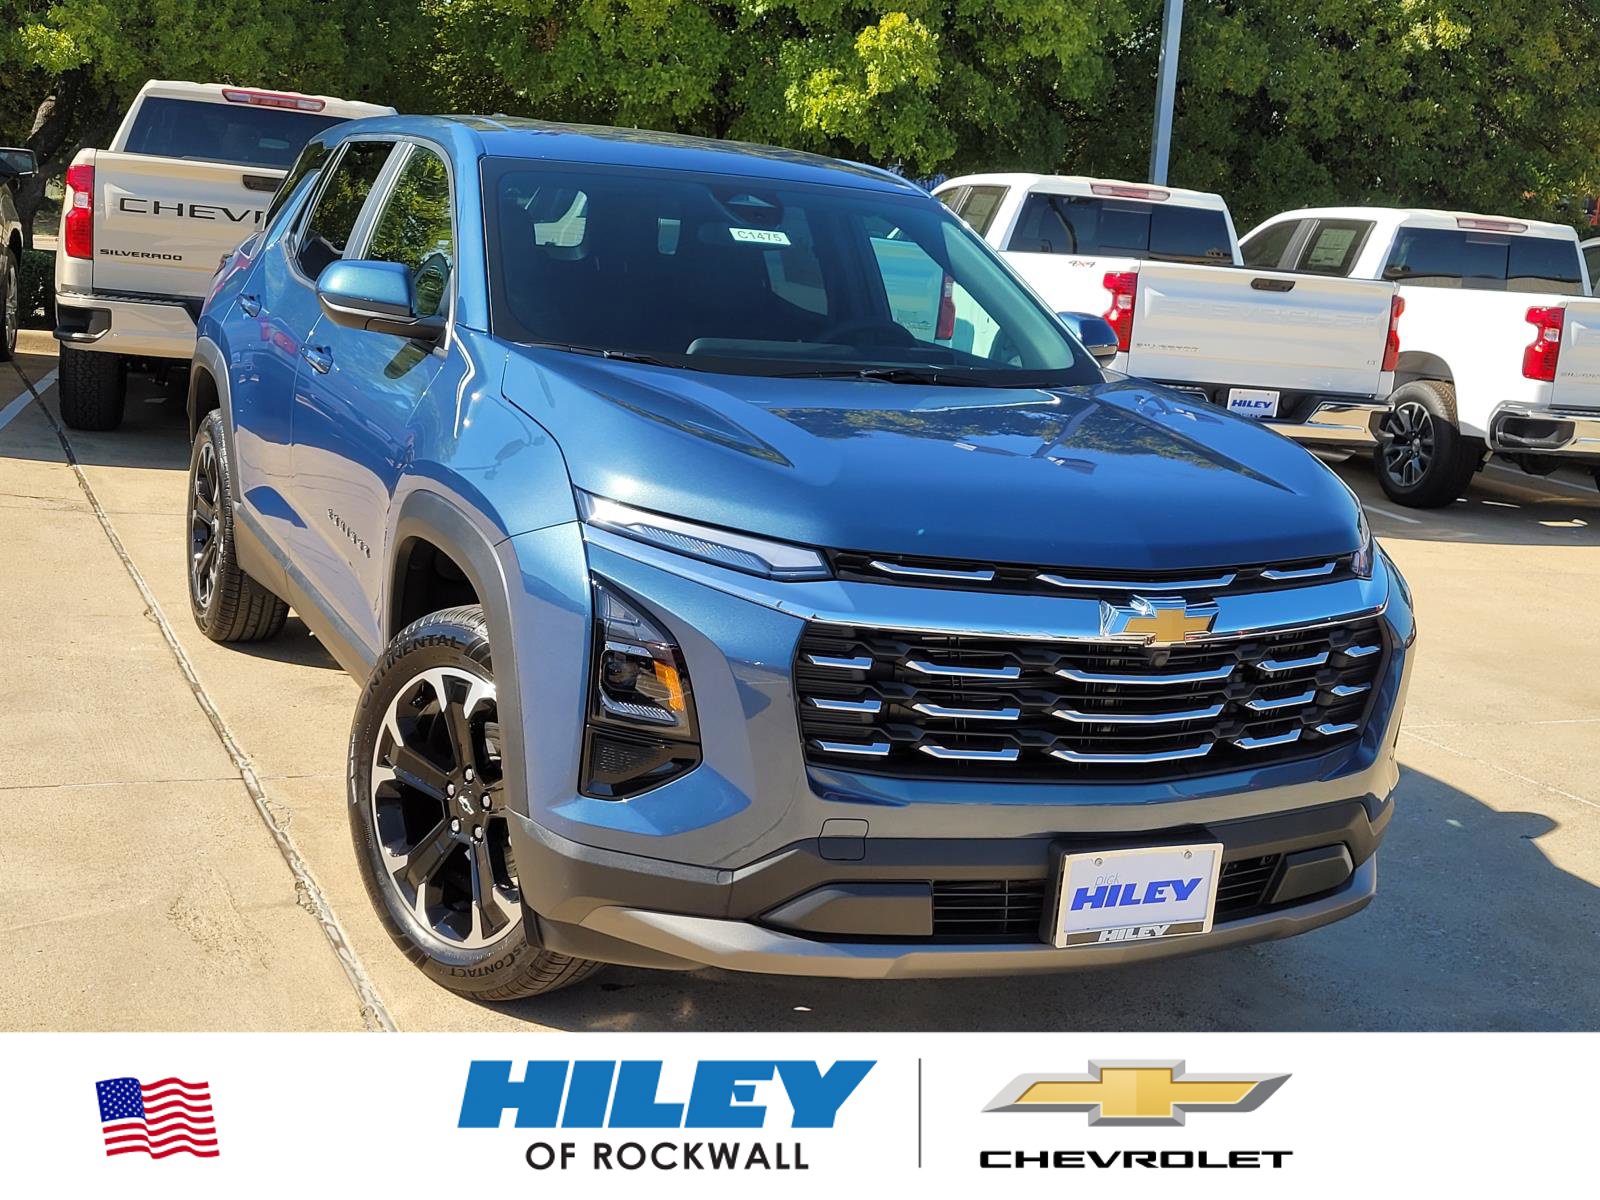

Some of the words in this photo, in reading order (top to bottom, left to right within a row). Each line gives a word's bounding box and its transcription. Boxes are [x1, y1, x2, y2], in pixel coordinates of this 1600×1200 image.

[737, 231, 782, 242] C1475
[99, 248, 182, 262] SILVERADO
[1231, 399, 1273, 409] HILEY
[1070, 877, 1203, 911] HILEY
[1098, 924, 1170, 943] HILEY
